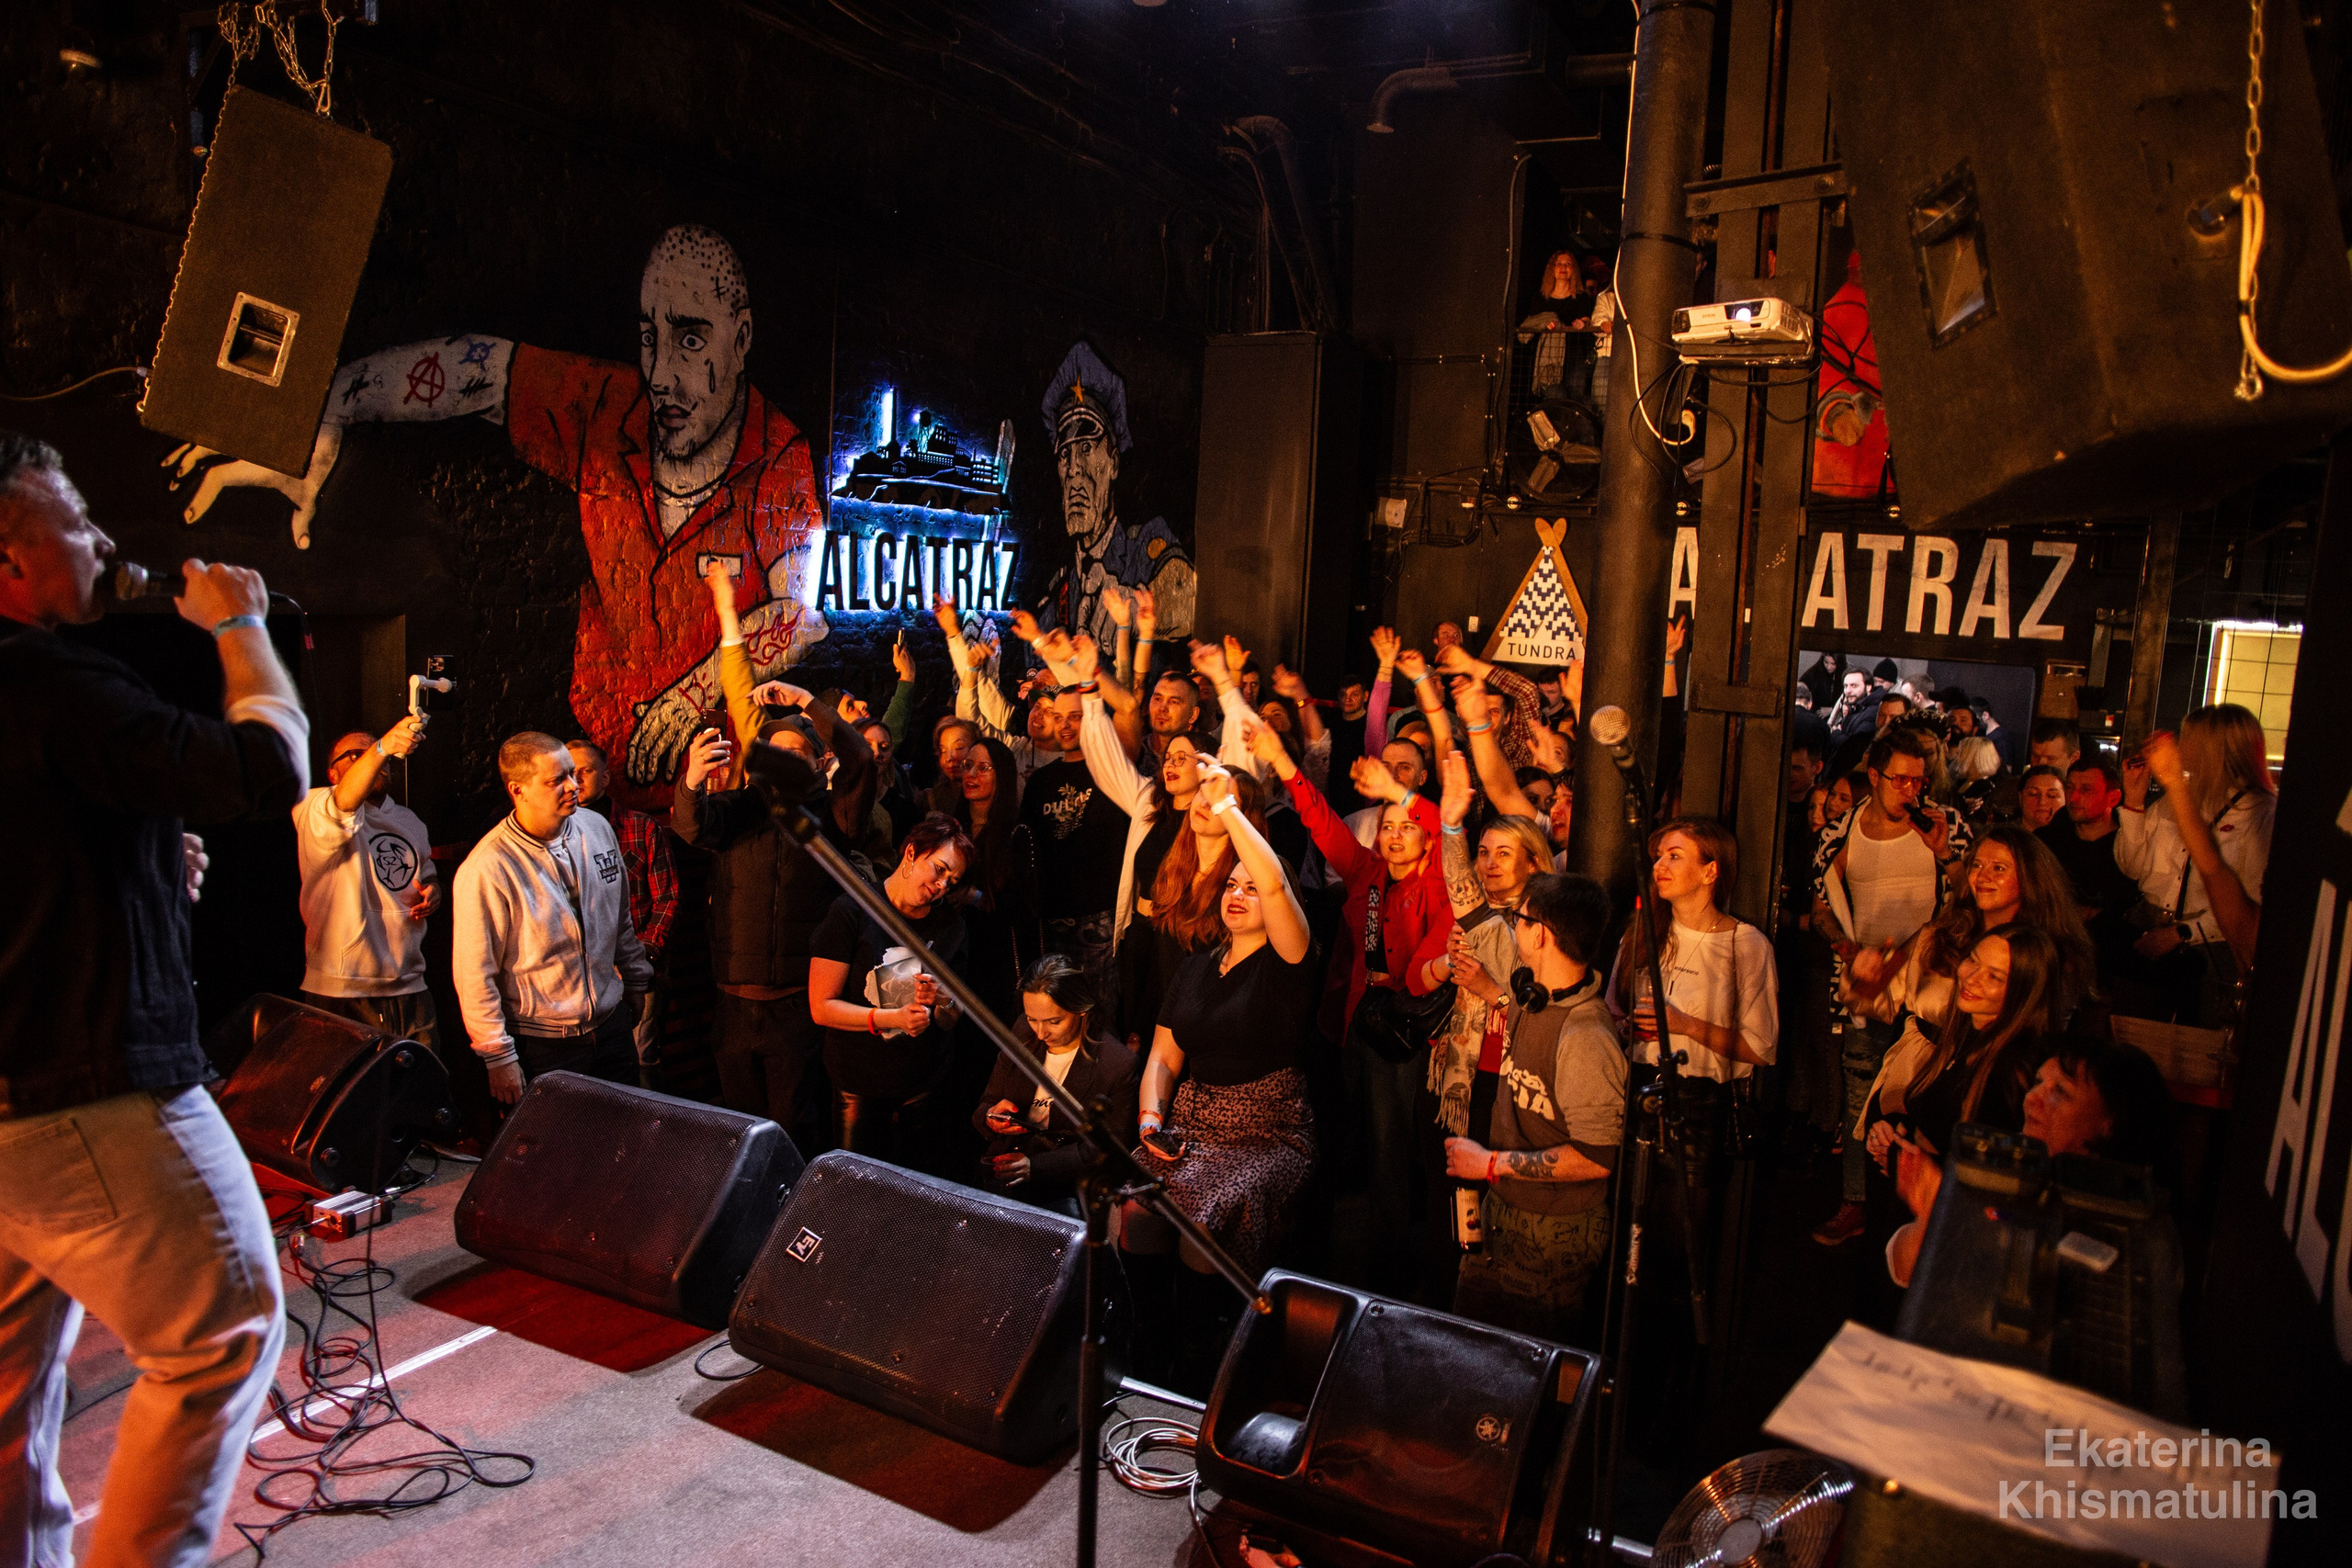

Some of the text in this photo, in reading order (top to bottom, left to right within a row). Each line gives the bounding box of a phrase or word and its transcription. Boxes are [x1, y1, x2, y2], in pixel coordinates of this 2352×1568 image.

[816, 530, 1021, 611] ALCATRAZ
[1668, 526, 2078, 641] AATRAZ
[1508, 642, 1576, 660] TUNDRA
